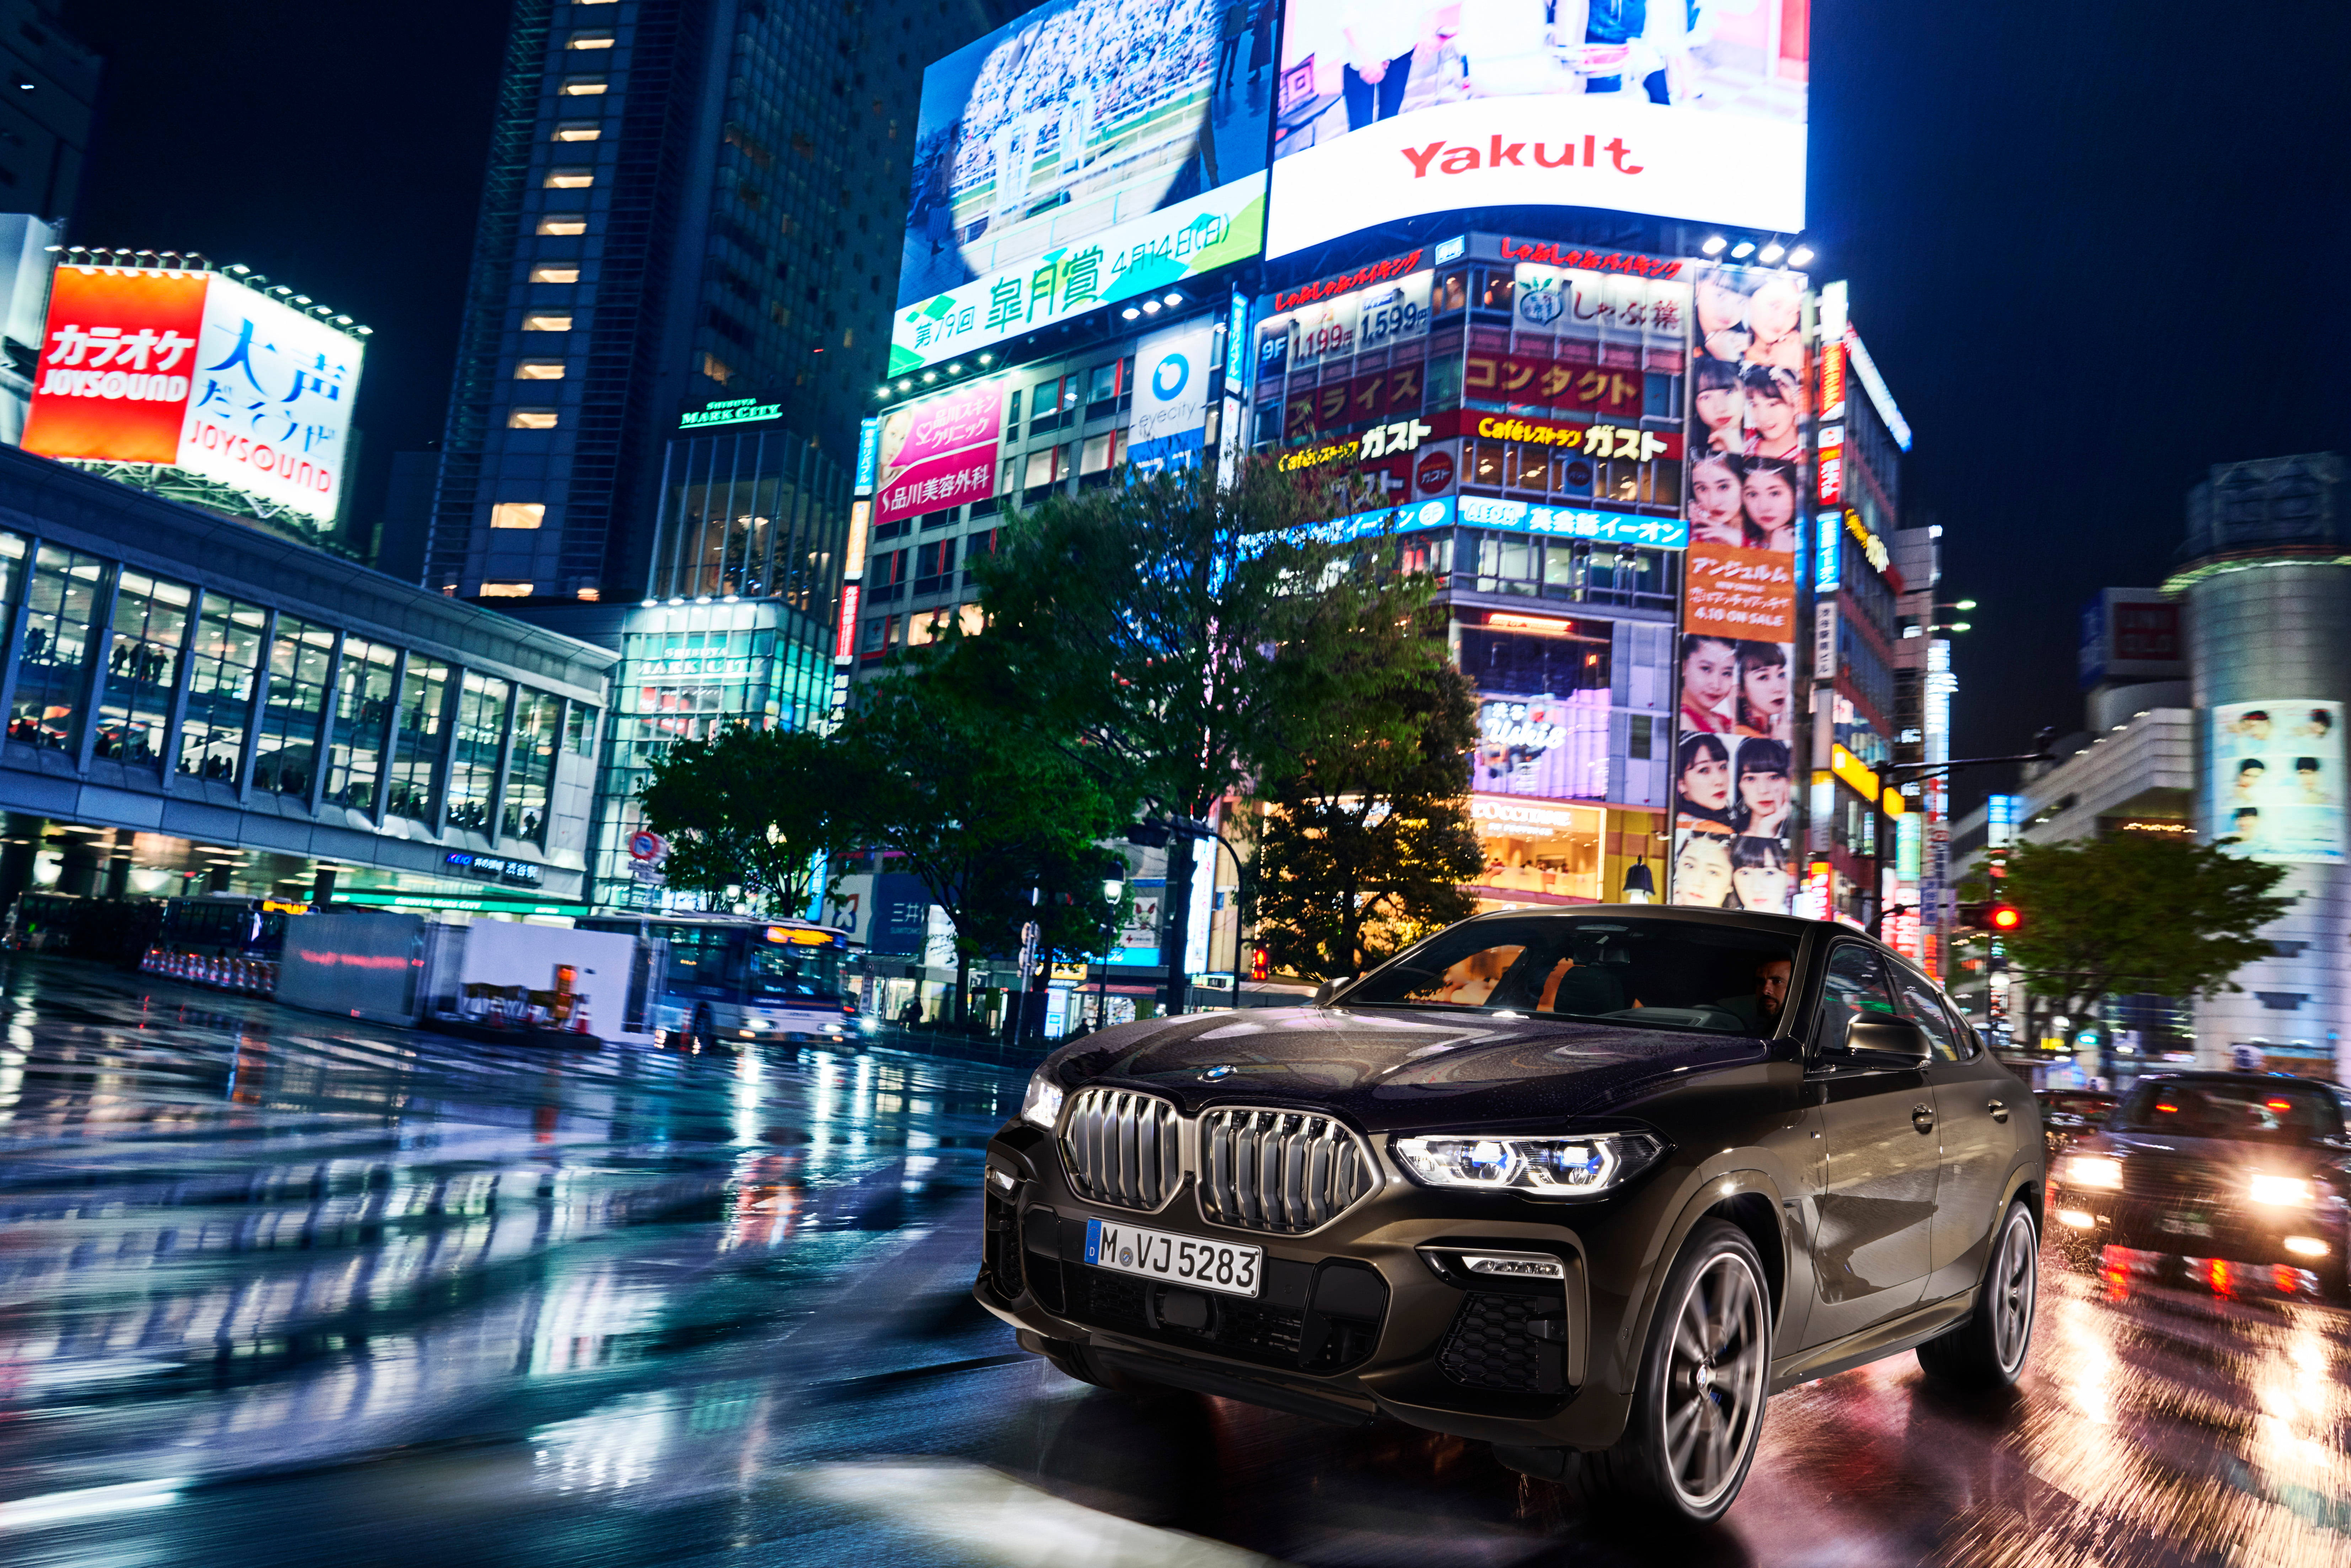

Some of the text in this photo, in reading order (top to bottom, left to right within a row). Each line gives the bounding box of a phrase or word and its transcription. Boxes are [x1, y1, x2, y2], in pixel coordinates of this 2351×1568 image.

[1401, 134, 1644, 178] Yakult
[914, 213, 1230, 350] 第79回 皐月賞 4月14日(日)
[47, 324, 196, 371] カラオケ
[204, 317, 348, 402] 大声
[1262, 336, 1287, 362] 9F
[40, 368, 188, 402] JOYSOUND
[1466, 357, 1637, 405] コンタクト
[681, 403, 782, 425] MARK CITY
[706, 398, 757, 411] SHIBUYA
[933, 395, 998, 428] 品川スキン
[1139, 402, 1197, 432] eyecity
[931, 417, 990, 449] クリニック
[1360, 419, 1431, 460] ガスト
[1583, 424, 1668, 462] ガスト
[189, 420, 331, 493] JOYSOUND
[891, 464, 990, 511] 品川美容外科
[1529, 507, 1684, 543] 英会話イーオン
[1694, 606, 1724, 621] 4.10
[1748, 612, 1786, 627] SALE
[446, 853, 473, 865] KEIO
[1089, 1247, 1095, 1256] D
[1100, 1226, 1256, 1288] M VJ 5283
